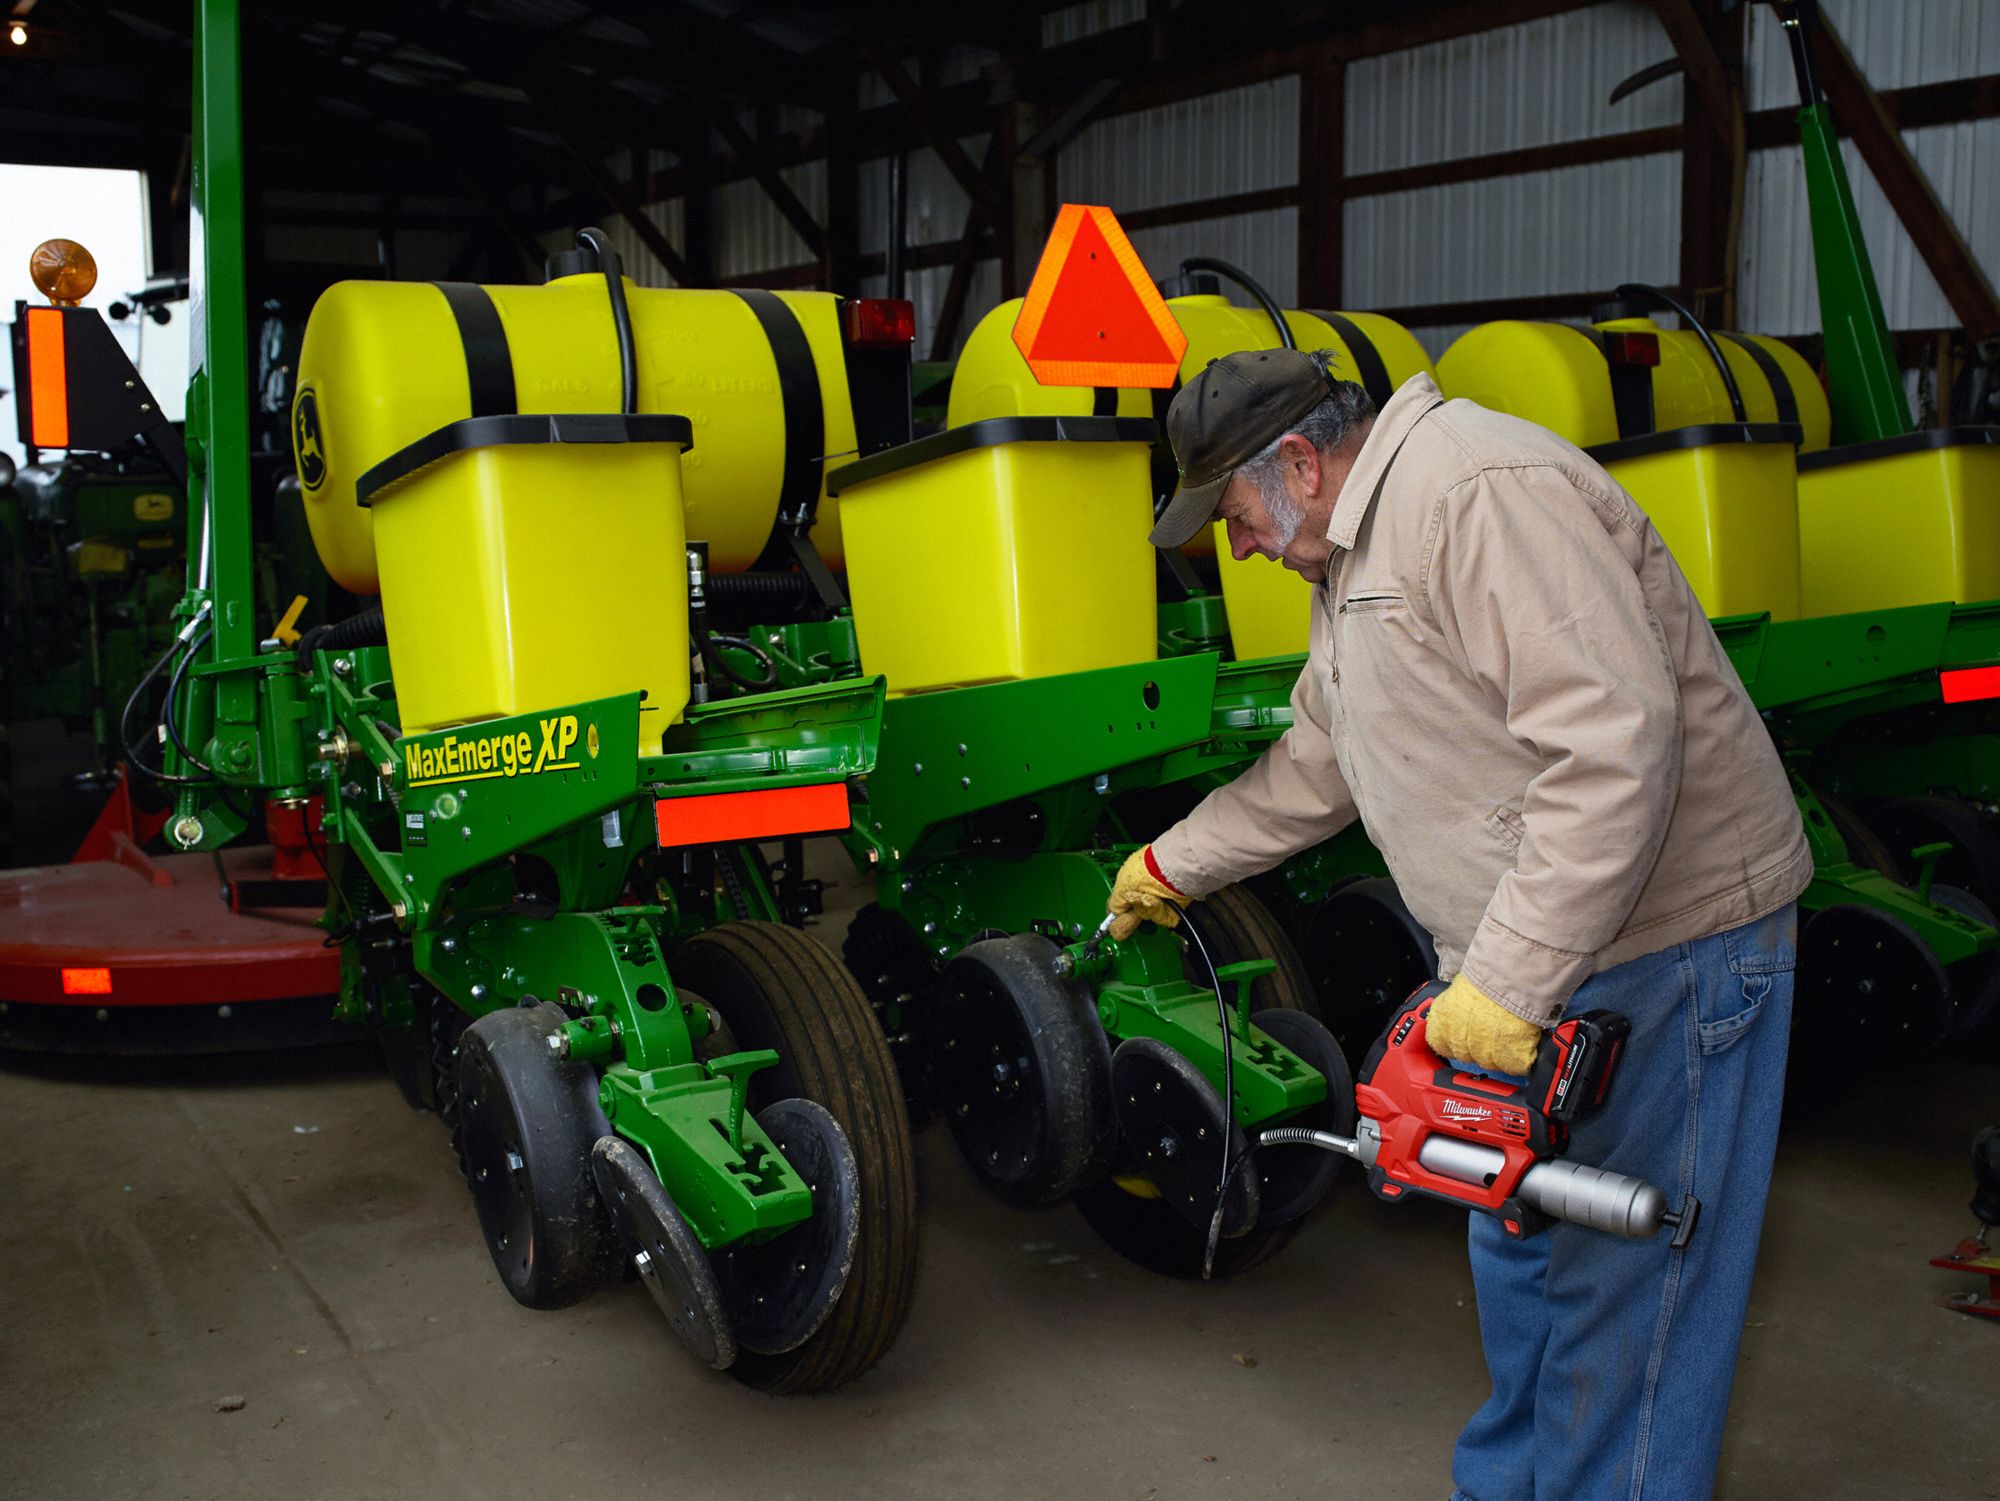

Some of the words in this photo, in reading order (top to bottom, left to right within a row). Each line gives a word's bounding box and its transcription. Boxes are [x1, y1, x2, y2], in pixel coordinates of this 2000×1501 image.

[405, 731, 533, 779] MaxEmerge
[532, 715, 579, 773] XP
[1442, 1098, 1492, 1117] Milwaukee
